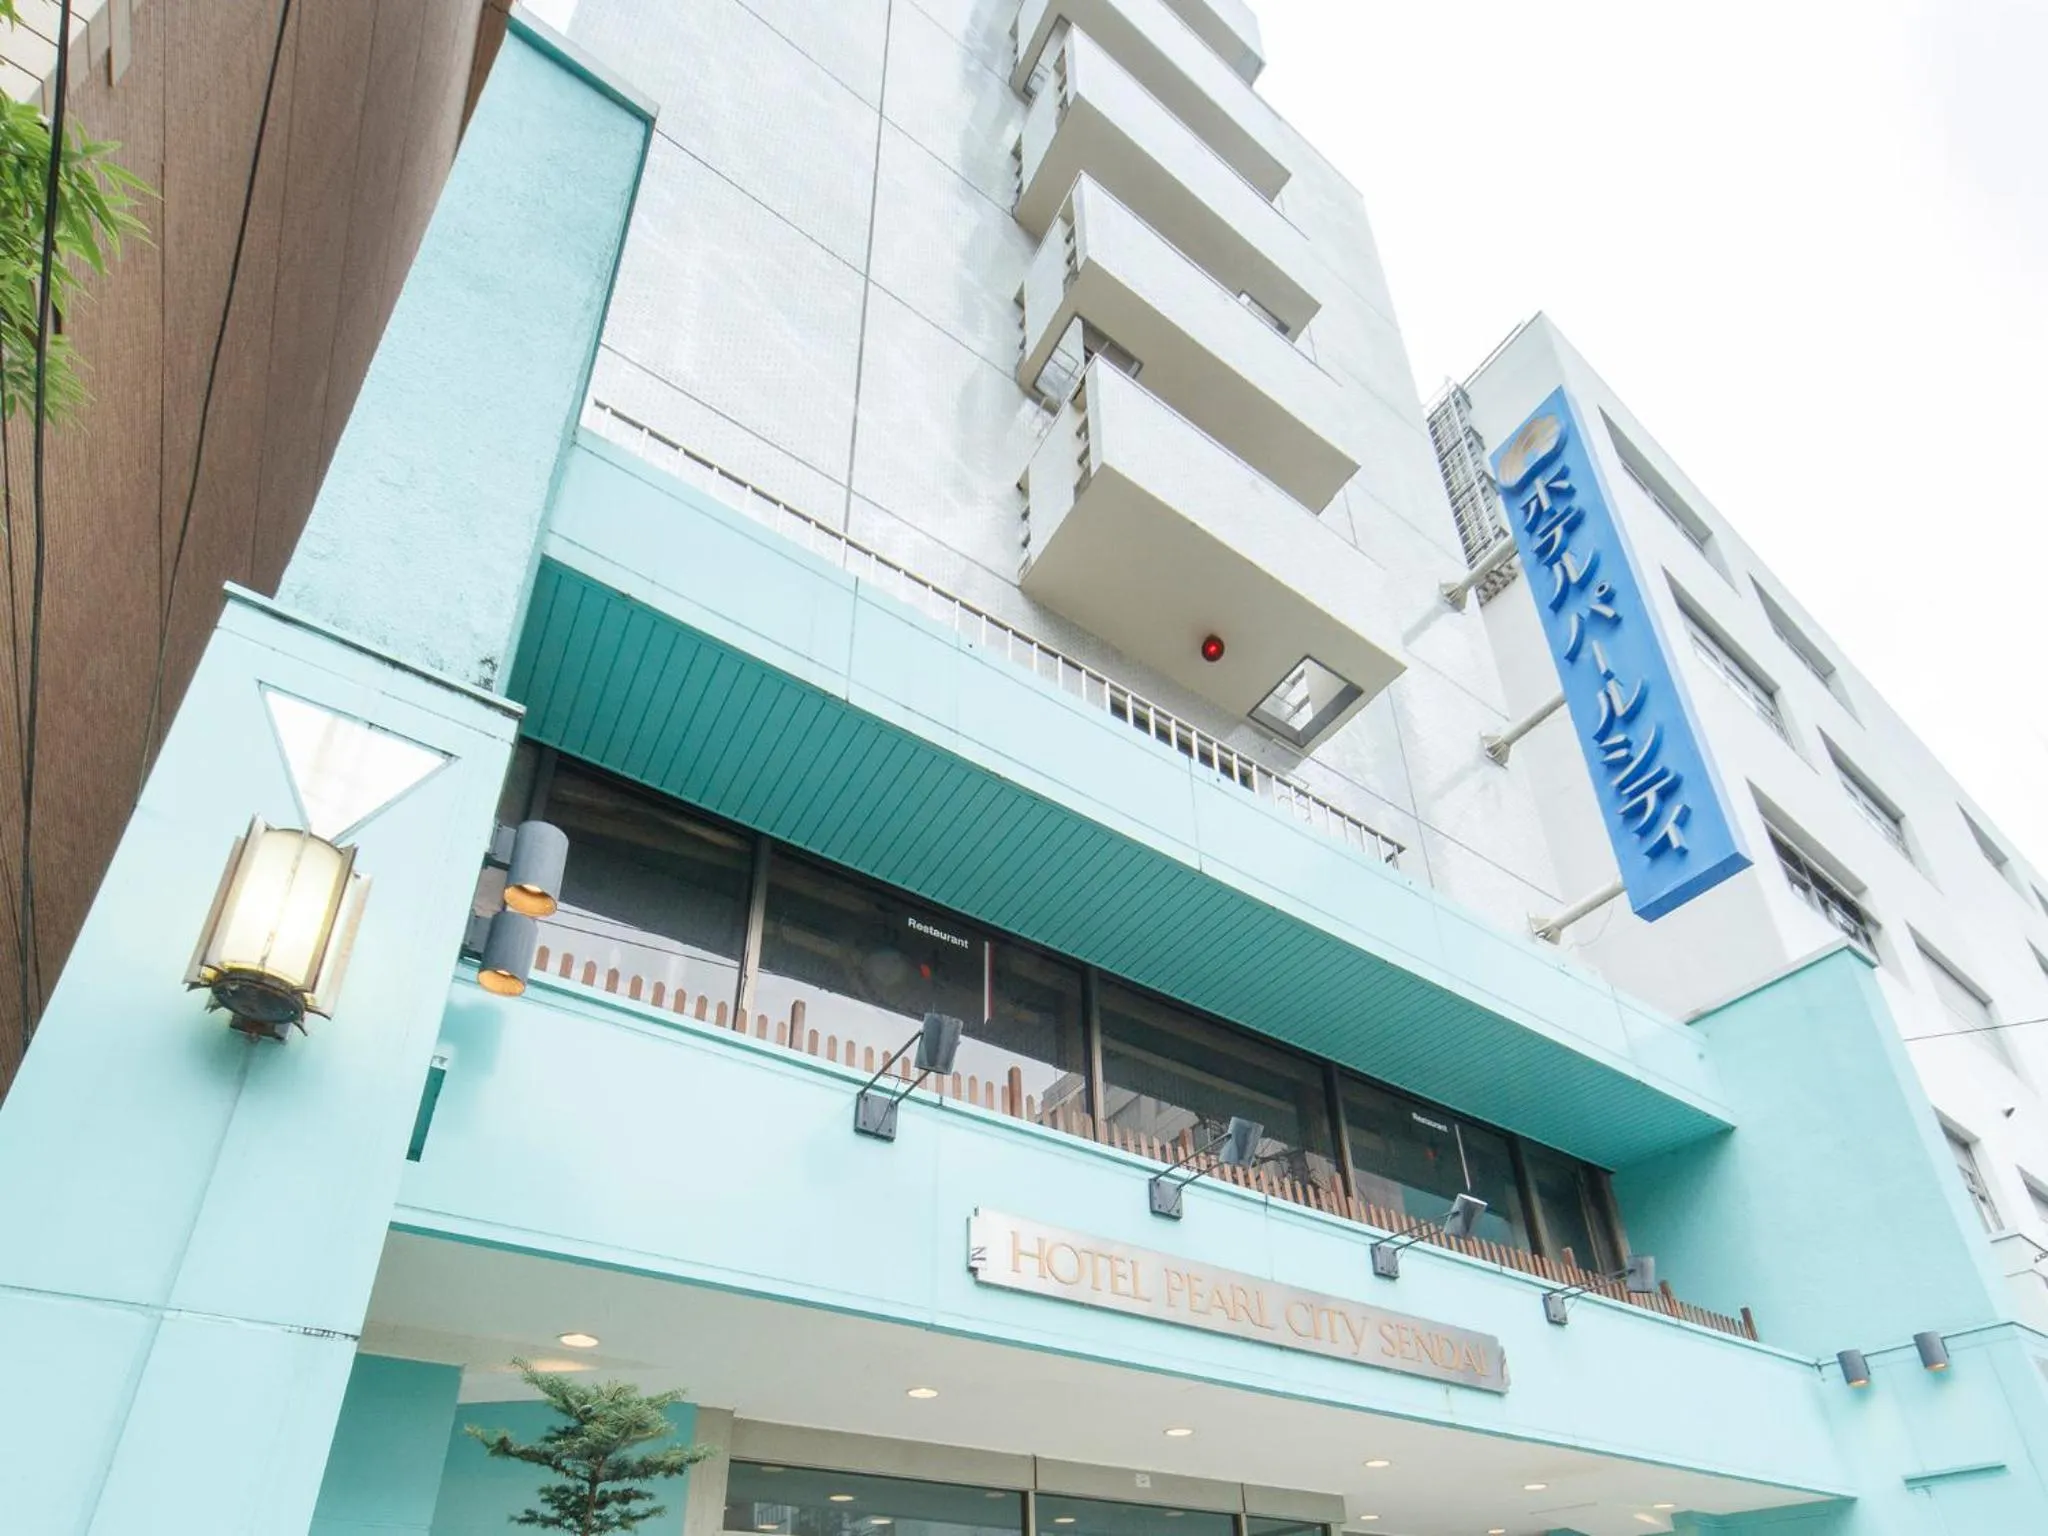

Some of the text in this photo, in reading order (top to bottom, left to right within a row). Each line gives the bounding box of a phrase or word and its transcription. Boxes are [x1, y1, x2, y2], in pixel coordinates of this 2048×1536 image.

[1520, 464, 1692, 860] ホテルパールシティ
[908, 917, 969, 949] Restaurant
[1010, 1231, 1490, 1377] HOTEL PEARL CITY SENDAI
